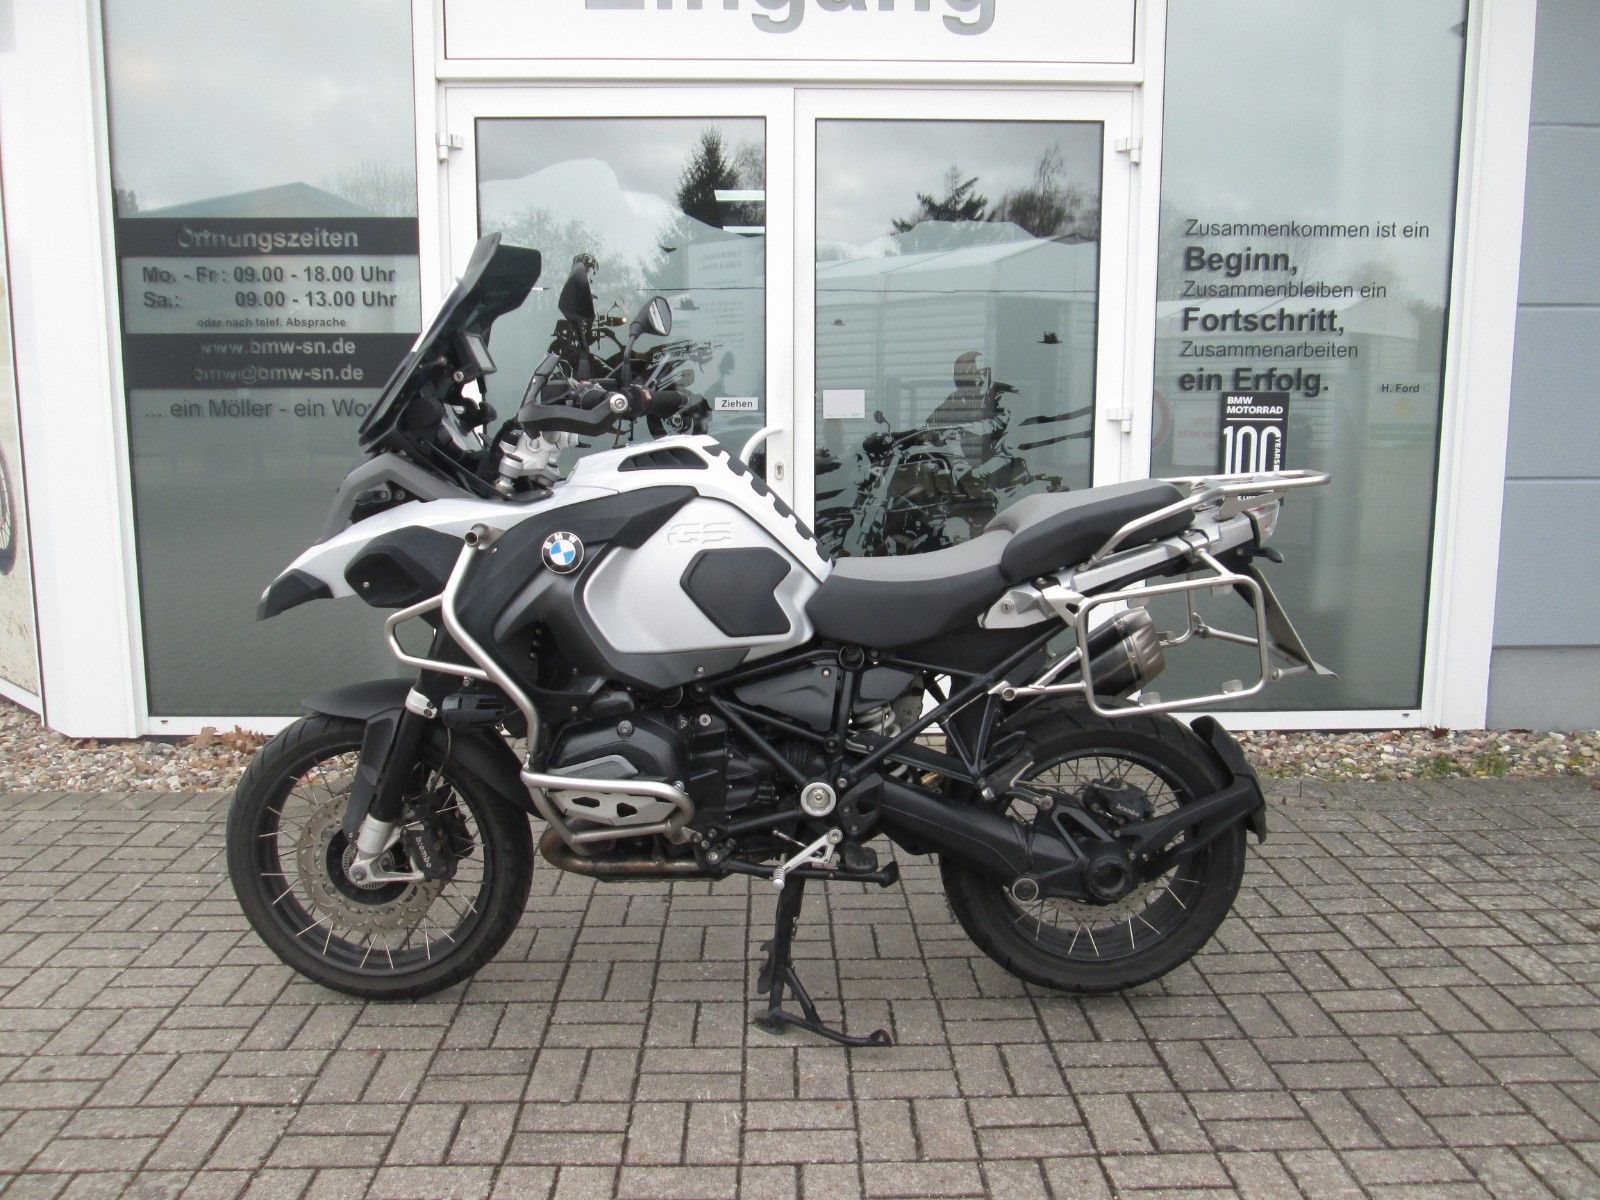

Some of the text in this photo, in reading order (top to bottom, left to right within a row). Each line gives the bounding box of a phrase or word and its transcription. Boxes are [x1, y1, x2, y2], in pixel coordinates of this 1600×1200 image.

[1185, 218, 1430, 239] Zusammenkommen ist ein
[1184, 245, 1298, 278] Beginn,
[142, 266, 176, 283] Mo.
[233, 265, 284, 283] 09.00
[303, 265, 354, 283] 18.00
[360, 265, 396, 283] Uhr
[1183, 279, 1387, 299] Zusammenbleiben ein
[235, 290, 286, 308] 09.00
[305, 290, 355, 308] 13.00
[361, 290, 398, 308] Uhr
[197, 318, 222, 327] oder
[225, 317, 253, 327] nach
[286, 316, 346, 329] Absprache
[1182, 306, 1345, 336] Fortschritt,
[1180, 340, 1359, 359] Zusammenarbeiten
[1178, 366, 1330, 398] ein Erfolg.
[1395, 383, 1420, 393] Ford
[170, 400, 201, 418] ein
[209, 398, 273, 418] Möller
[294, 402, 326, 417] ein
[332, 399, 374, 417] Wo
[721, 399, 753, 408] Ziehen
[1226, 405, 1284, 415] MOTORRAD
[1227, 396, 1253, 405] BMW
[1223, 425, 1282, 475] 100
[1273, 436, 1282, 465] YEARS
[542, 531, 579, 550] BMW
